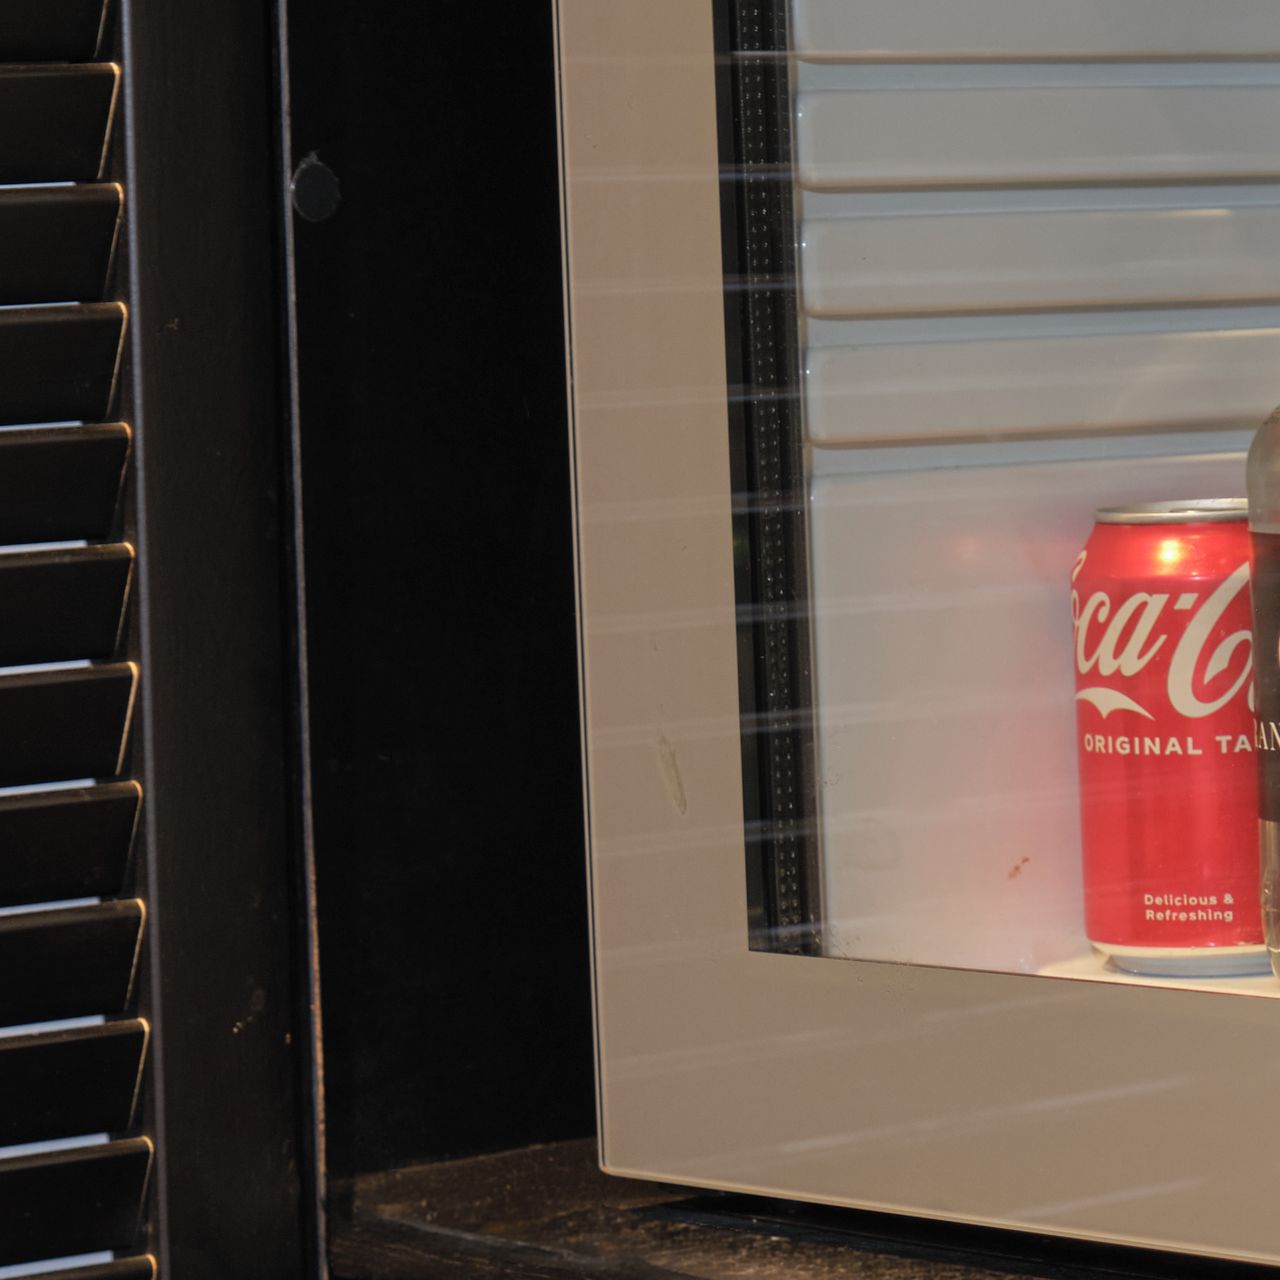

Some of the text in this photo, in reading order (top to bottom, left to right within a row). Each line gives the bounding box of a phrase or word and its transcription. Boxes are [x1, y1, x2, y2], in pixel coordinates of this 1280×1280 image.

[1084, 734, 1252, 756] ORIGINAL TA
[1144, 893, 1234, 906] Delicious &
[1145, 909, 1233, 922] Refreshing
